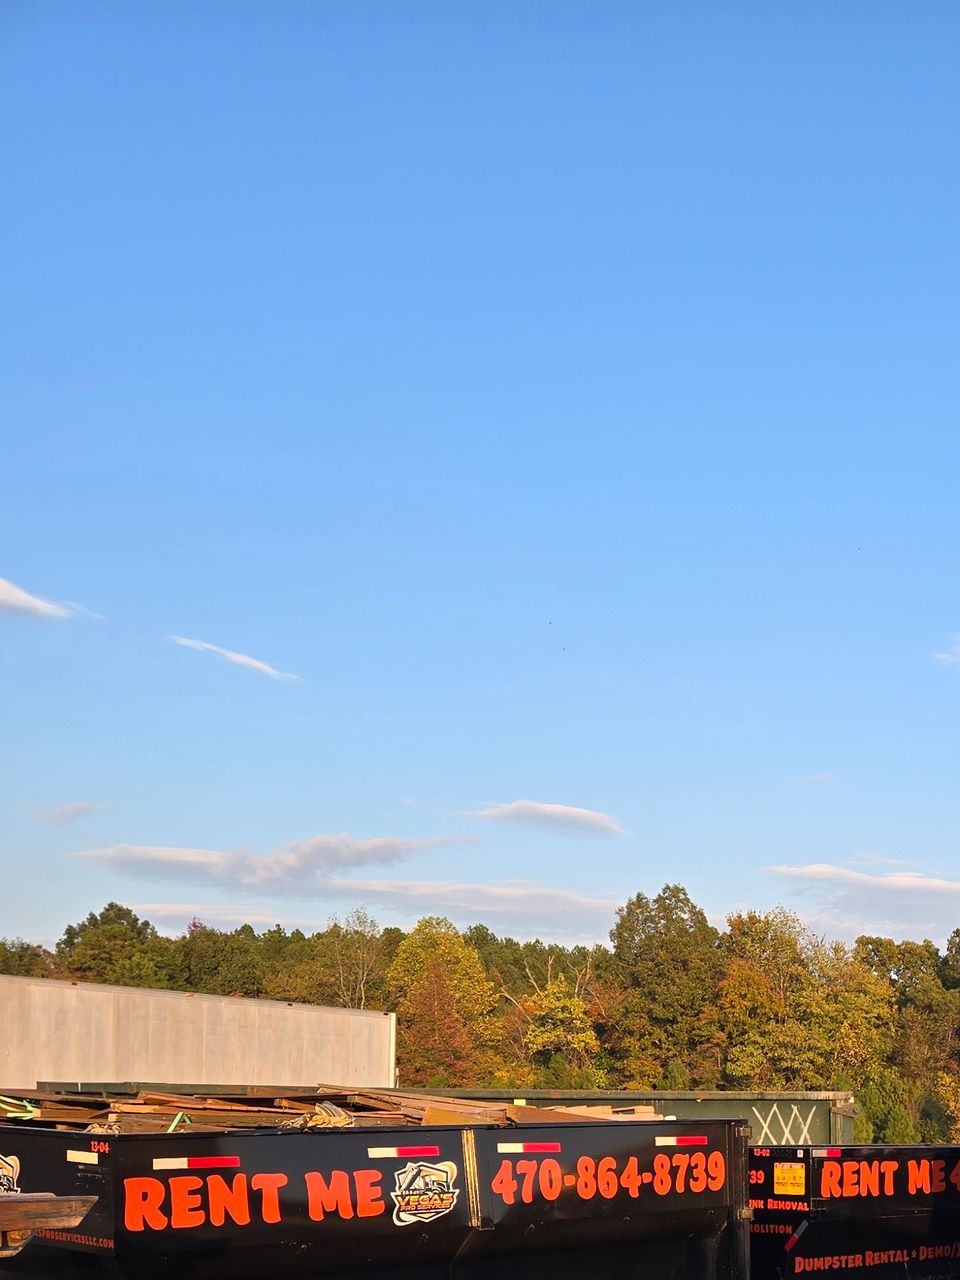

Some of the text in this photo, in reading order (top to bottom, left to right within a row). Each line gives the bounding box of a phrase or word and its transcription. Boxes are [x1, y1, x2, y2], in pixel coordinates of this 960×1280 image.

[90, 1141, 109, 1153] 13-04
[753, 1148, 771, 1157] 13-02
[491, 1150, 726, 1204] 470-864-8739
[821, 1160, 899, 1198] RENT
[908, 1159, 946, 1195] ME
[124, 1169, 385, 1232] RENT ME
[397, 1194, 453, 1206] VEGA'S
[767, 1199, 809, 1212] REMOVAL
[794, 1255, 863, 1273] DUMPSTER
[865, 1249, 910, 1267] RENTAL
